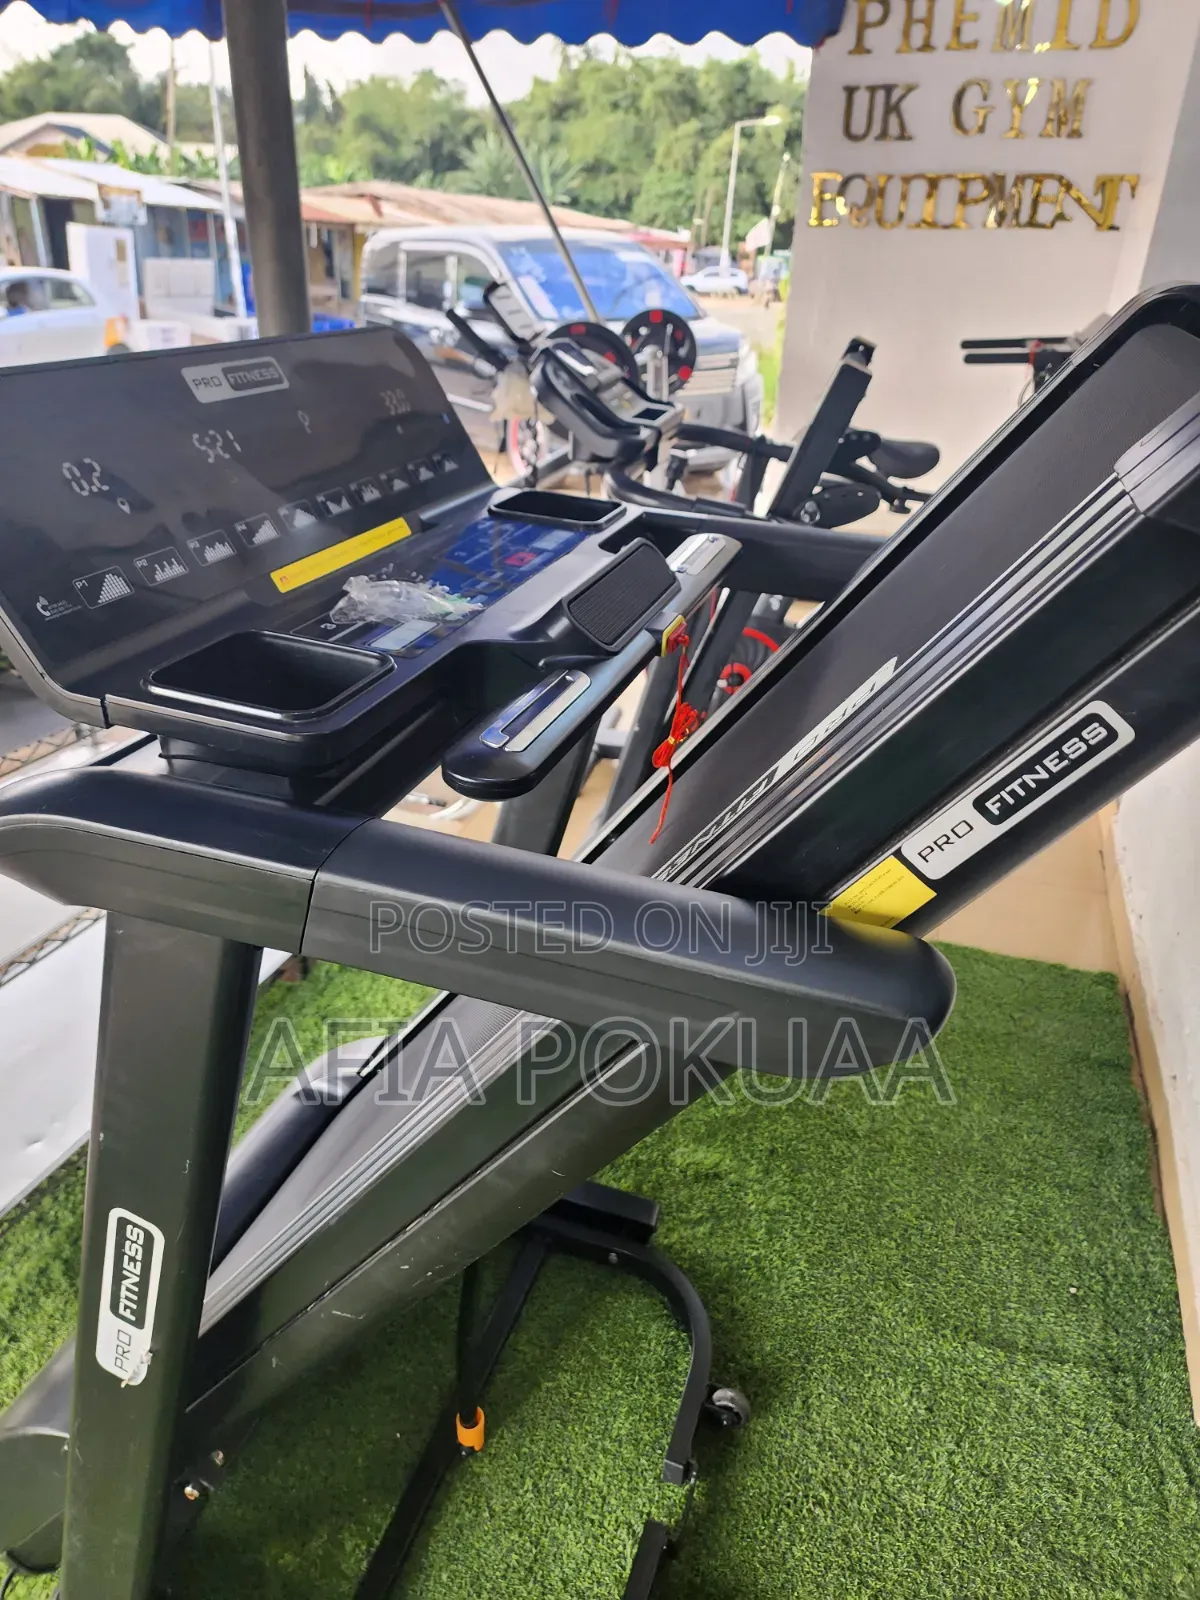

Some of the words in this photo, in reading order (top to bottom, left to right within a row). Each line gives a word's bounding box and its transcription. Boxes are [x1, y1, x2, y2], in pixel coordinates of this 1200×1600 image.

[842, 83, 919, 142] UK
[952, 78, 1093, 139] GYM
[808, 171, 1140, 231] EQUIPMENT
[192, 375, 223, 390] PRO
[227, 366, 280, 385] FITNESS
[75, 579, 88, 589] P1
[136, 558, 148, 567] P2
[917, 819, 974, 863] PRO
[984, 722, 1108, 816] FITNESS
[118, 1224, 145, 1321] FITNESS
[115, 1329, 132, 1373] PRO
